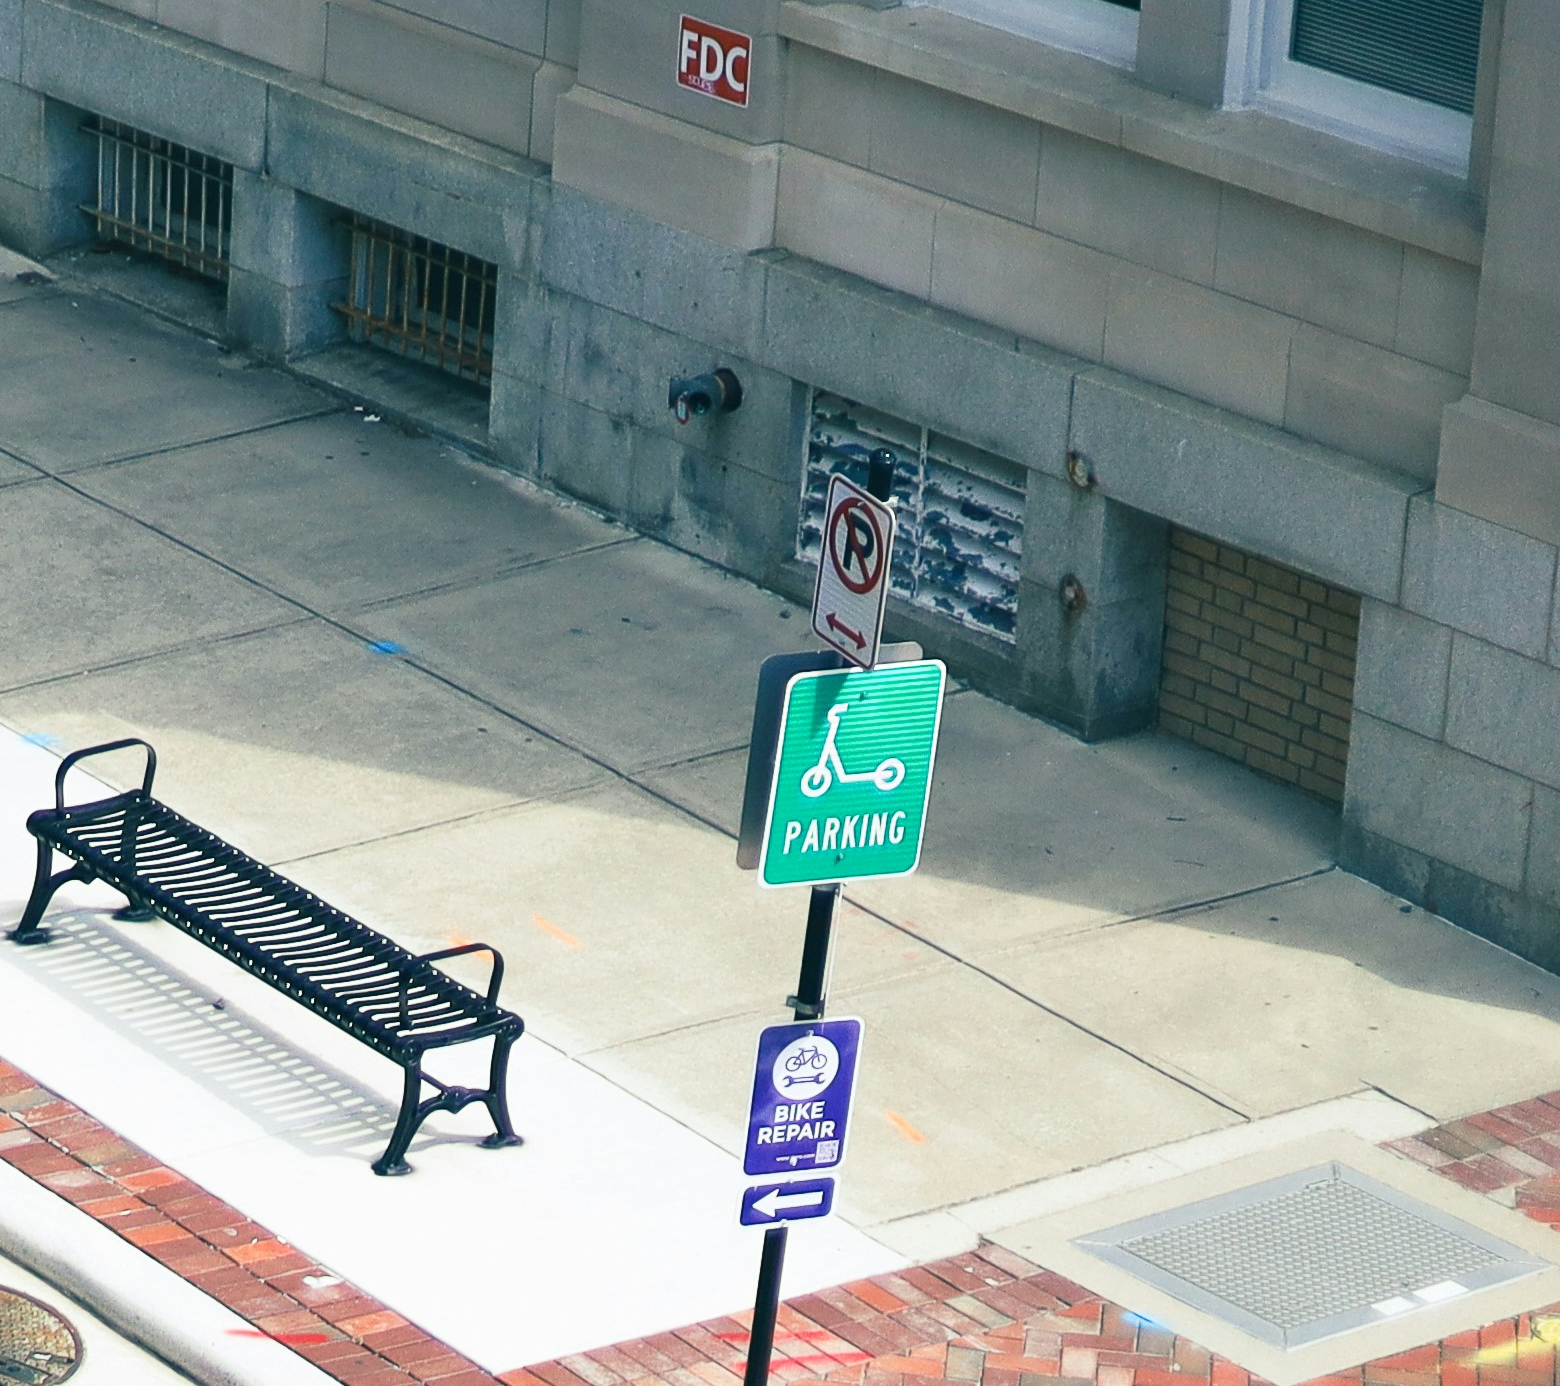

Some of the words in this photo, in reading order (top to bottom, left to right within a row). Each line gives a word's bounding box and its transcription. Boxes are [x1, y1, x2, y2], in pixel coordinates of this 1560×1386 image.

[680, 29, 747, 93] FDC
[782, 810, 907, 855] PARKING
[774, 1101, 825, 1124] BIKE
[757, 1120, 836, 1145] REPAIR
